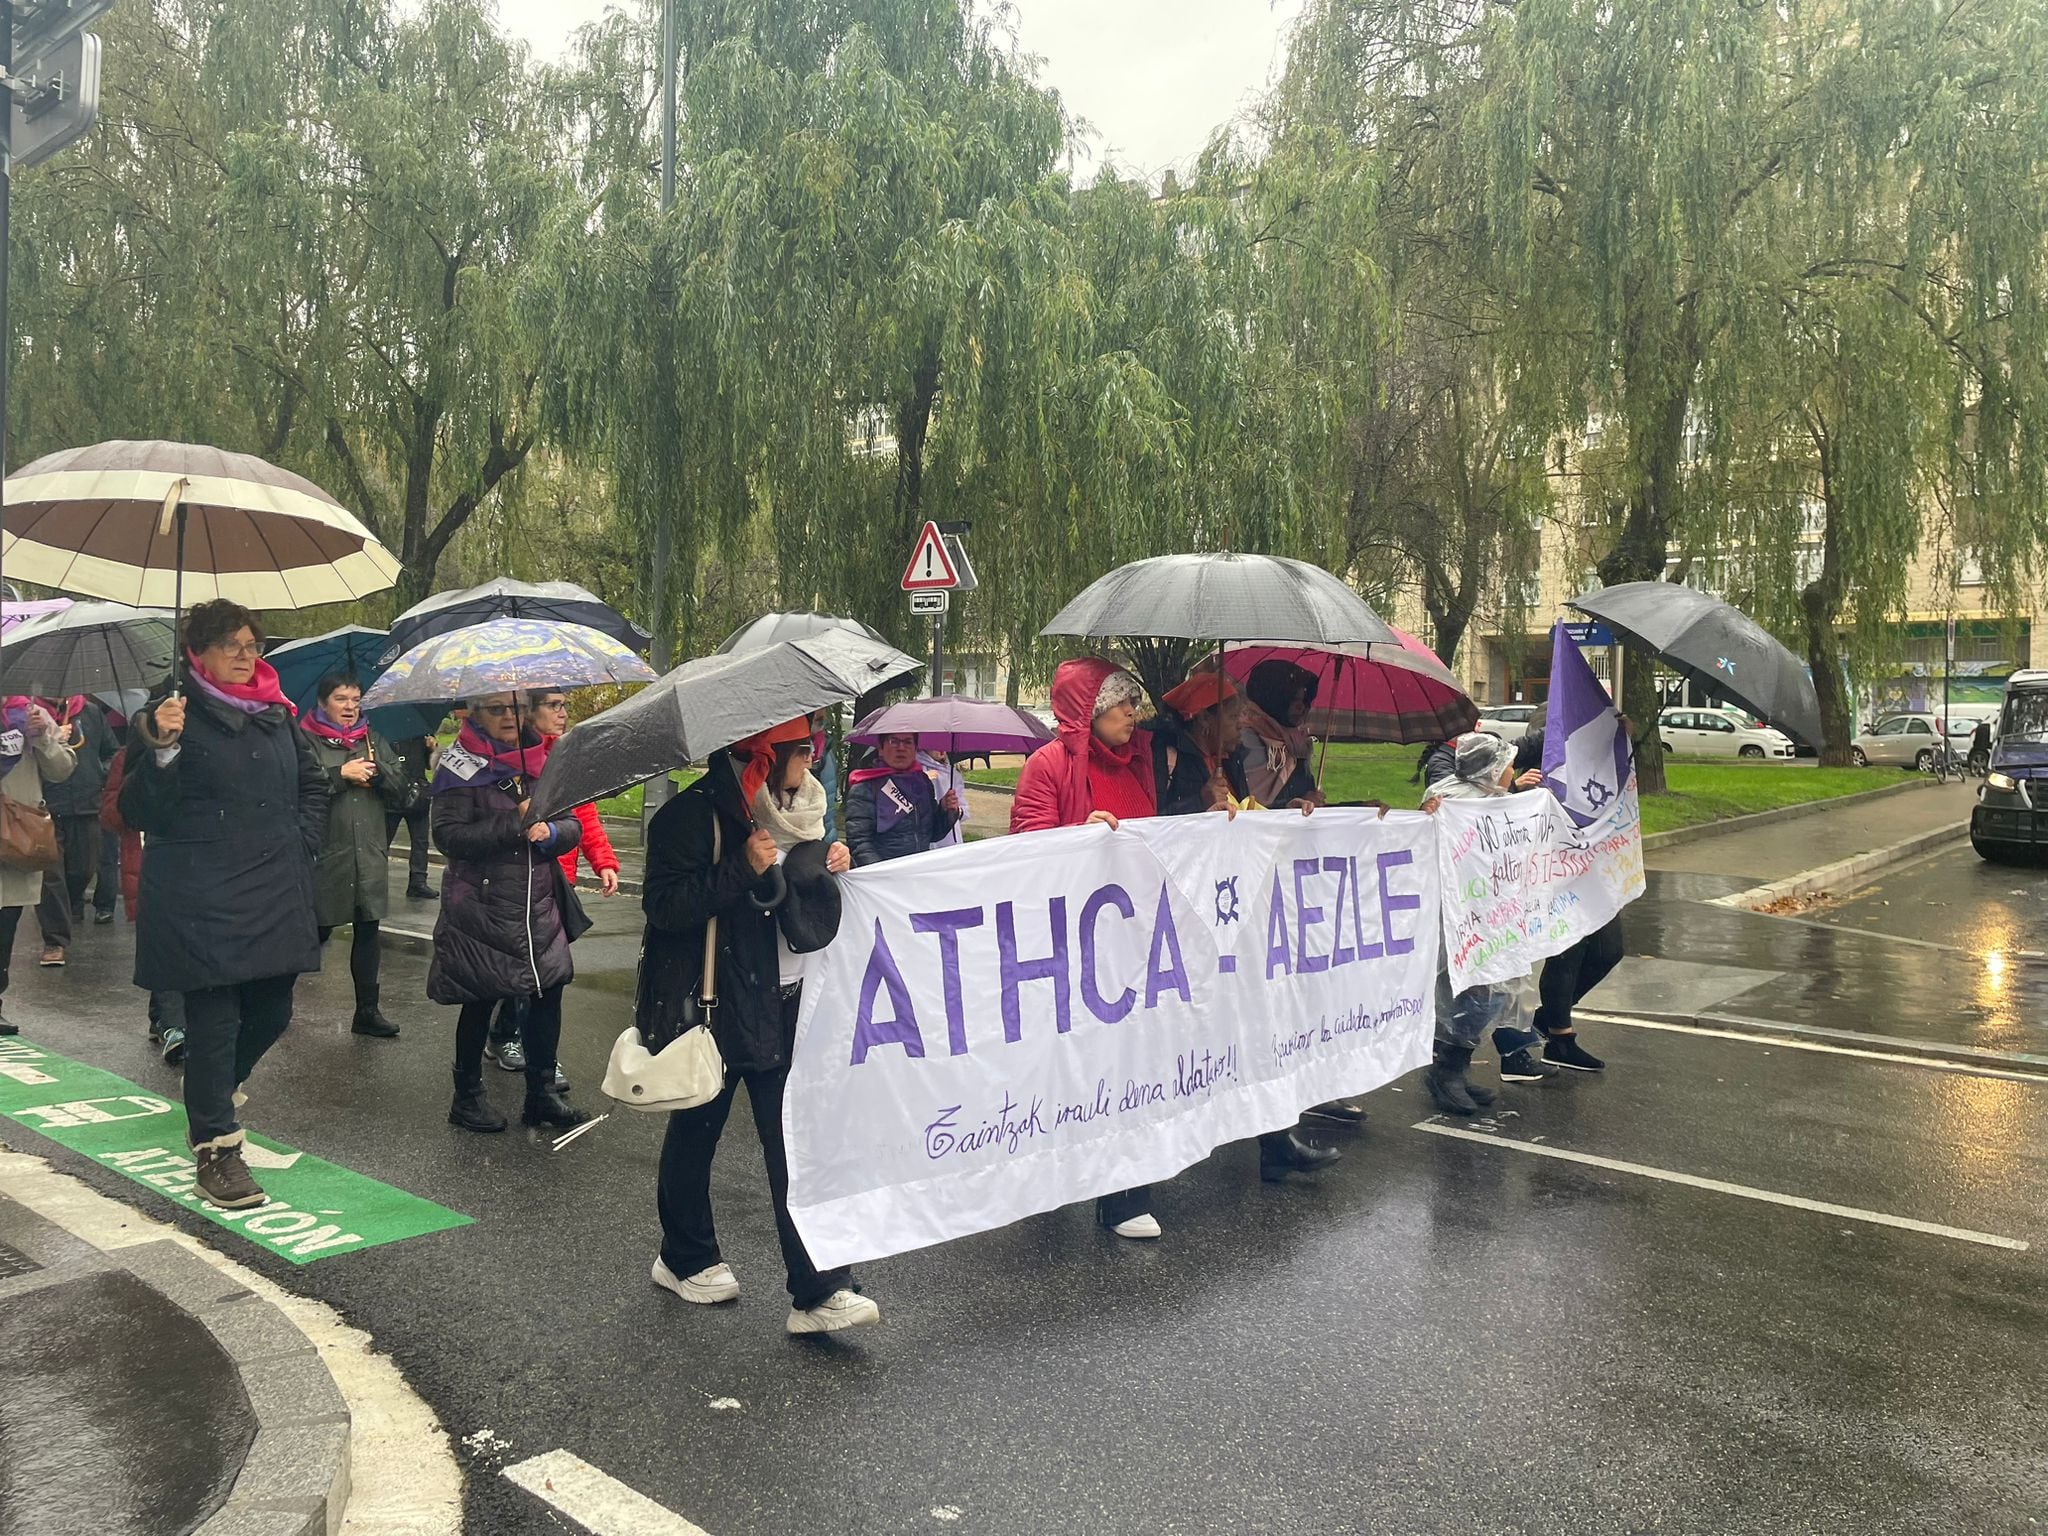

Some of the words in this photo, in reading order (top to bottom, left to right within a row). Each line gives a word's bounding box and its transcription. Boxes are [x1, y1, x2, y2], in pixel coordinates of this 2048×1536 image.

[1451, 825, 1478, 865] HILDA
[1476, 815, 1500, 853] NO
[850, 880, 1193, 1067] ATHCA
[1265, 849, 1421, 980] AEZLE
[97, 1147, 365, 1255] ATEIÓN
